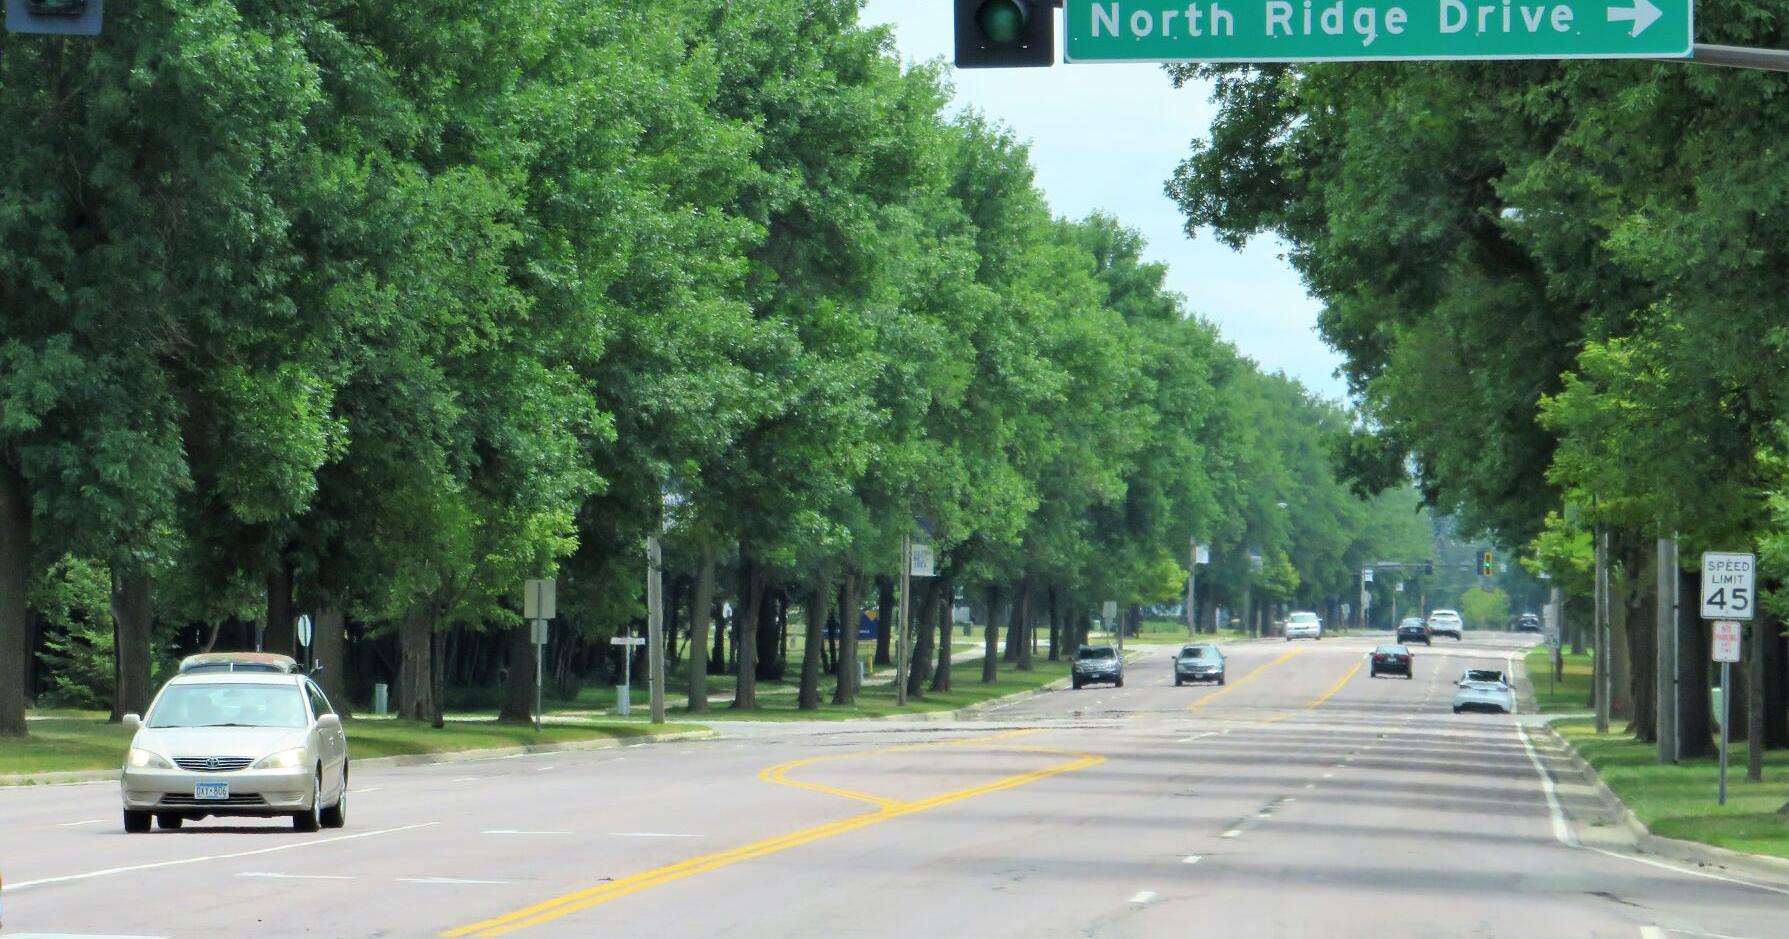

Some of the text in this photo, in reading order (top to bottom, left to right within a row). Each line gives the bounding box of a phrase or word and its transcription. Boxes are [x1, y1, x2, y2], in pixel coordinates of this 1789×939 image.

[1091, 0, 1574, 47] North Ridge Drive
[1708, 561, 1750, 571] SPEED
[1712, 575, 1744, 584] LIMIT
[1706, 587, 1749, 611] 45
